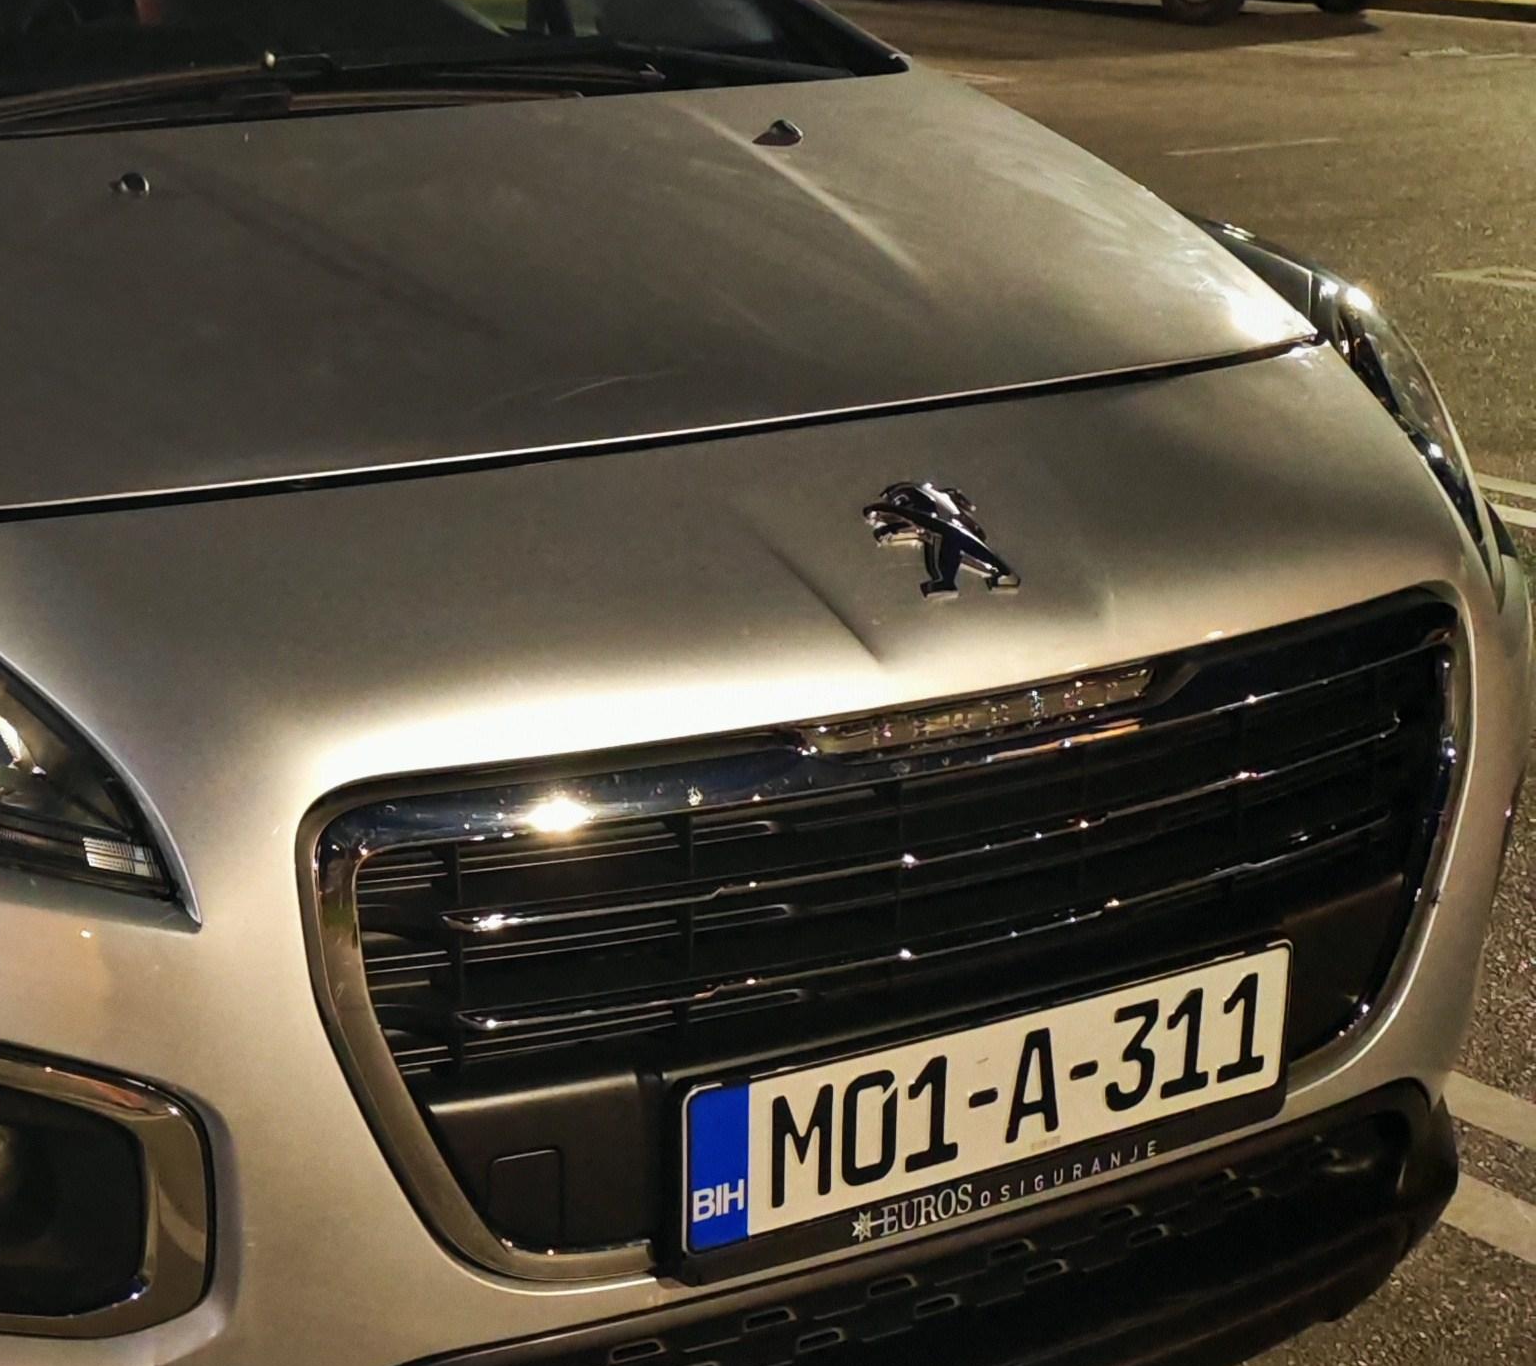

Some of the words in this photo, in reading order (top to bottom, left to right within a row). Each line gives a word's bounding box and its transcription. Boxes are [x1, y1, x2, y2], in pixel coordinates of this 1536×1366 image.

[691, 1178, 745, 1225] BIH
[880, 1183, 973, 1237] EUROS
[980, 1139, 1158, 1208] OSIGURANJE
